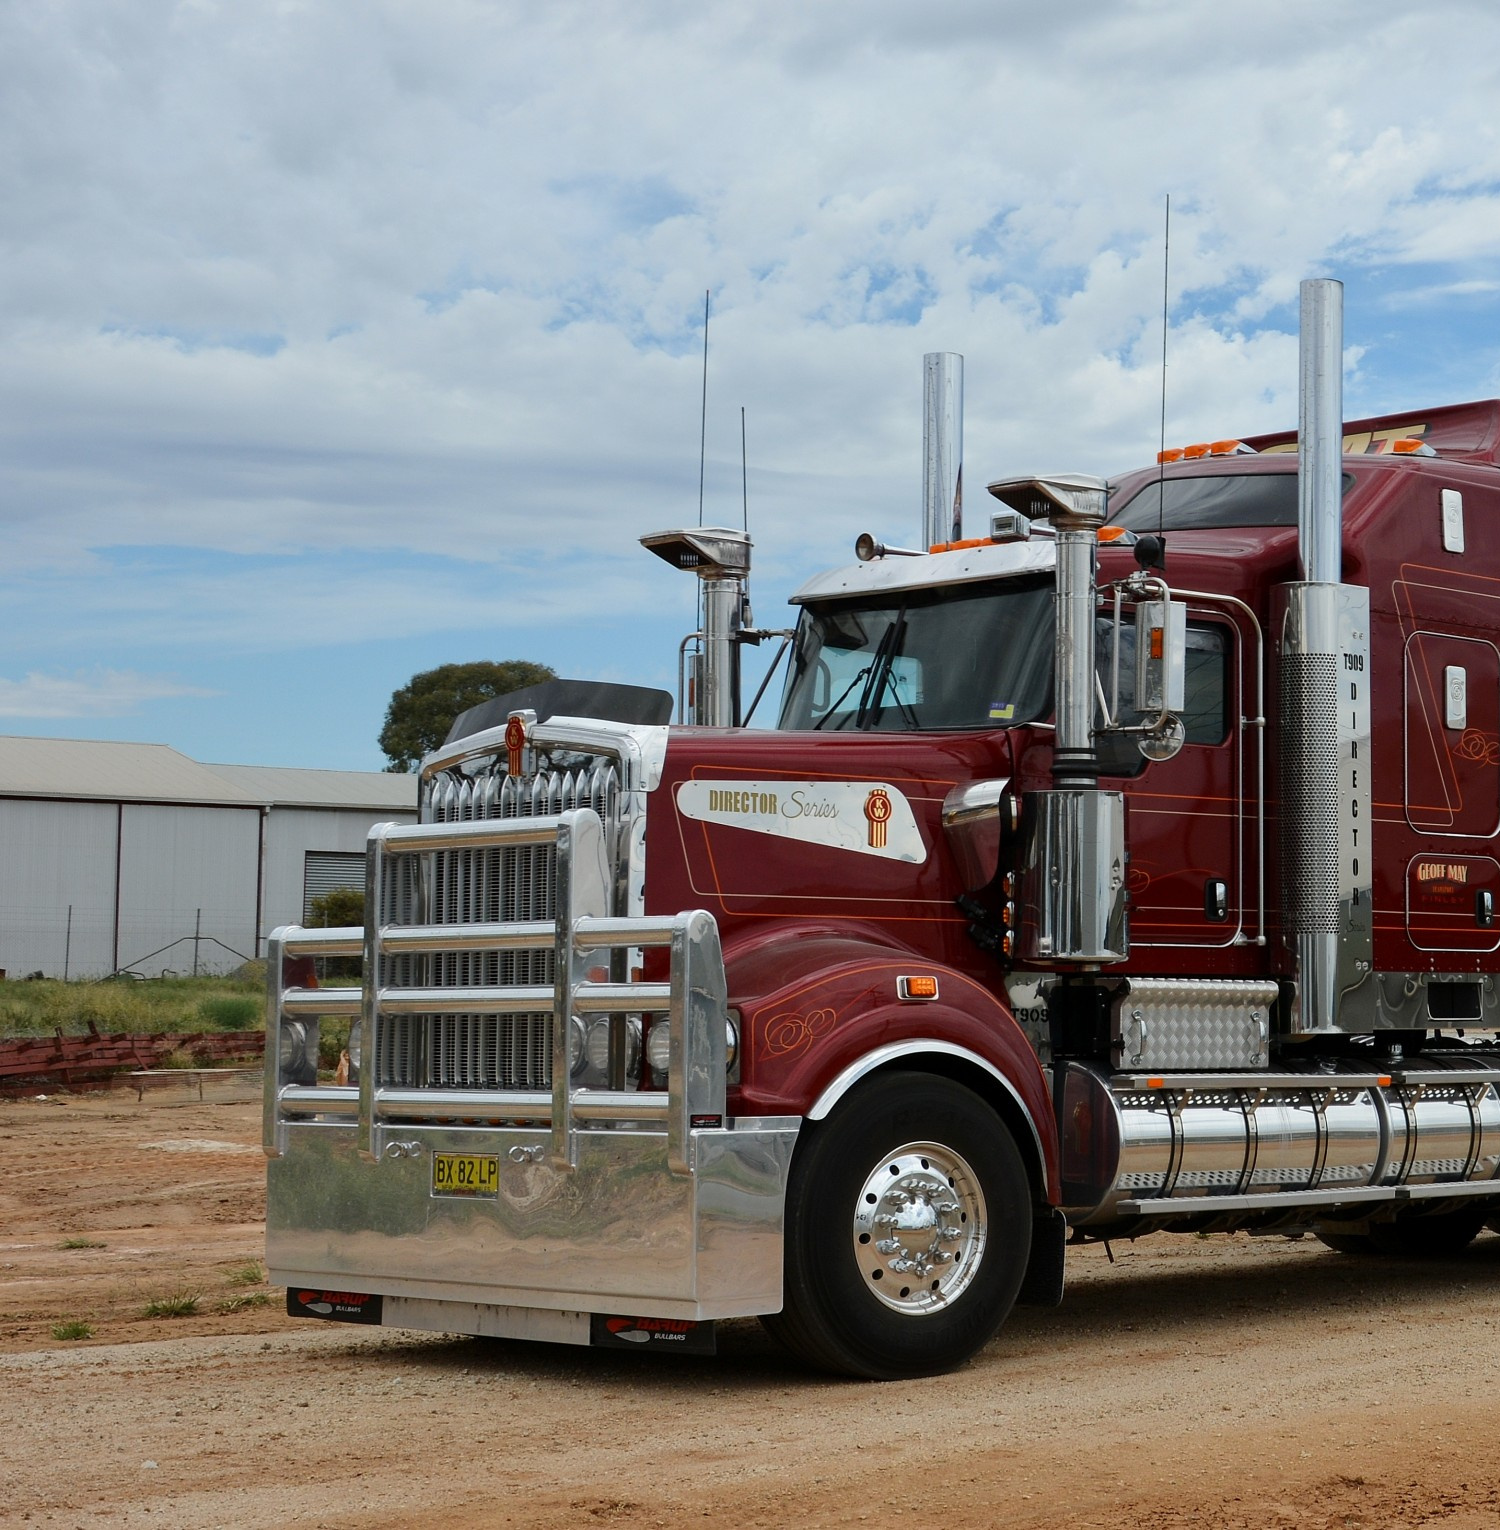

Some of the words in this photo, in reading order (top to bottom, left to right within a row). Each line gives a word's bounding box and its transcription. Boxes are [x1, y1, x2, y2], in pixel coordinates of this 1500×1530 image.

[1343, 653, 1364, 671] T909
[1350, 682, 1360, 906] DIRECTOR
[709, 789, 777, 815] DIRECTOR
[781, 790, 840, 819] Series
[1417, 863, 1446, 881] GEOFF
[1447, 865, 1468, 882] MAY
[1011, 1008, 1049, 1023] T909
[335, 1305, 362, 1313] BULLBARS
[654, 1333, 687, 1341] BULLBARS
